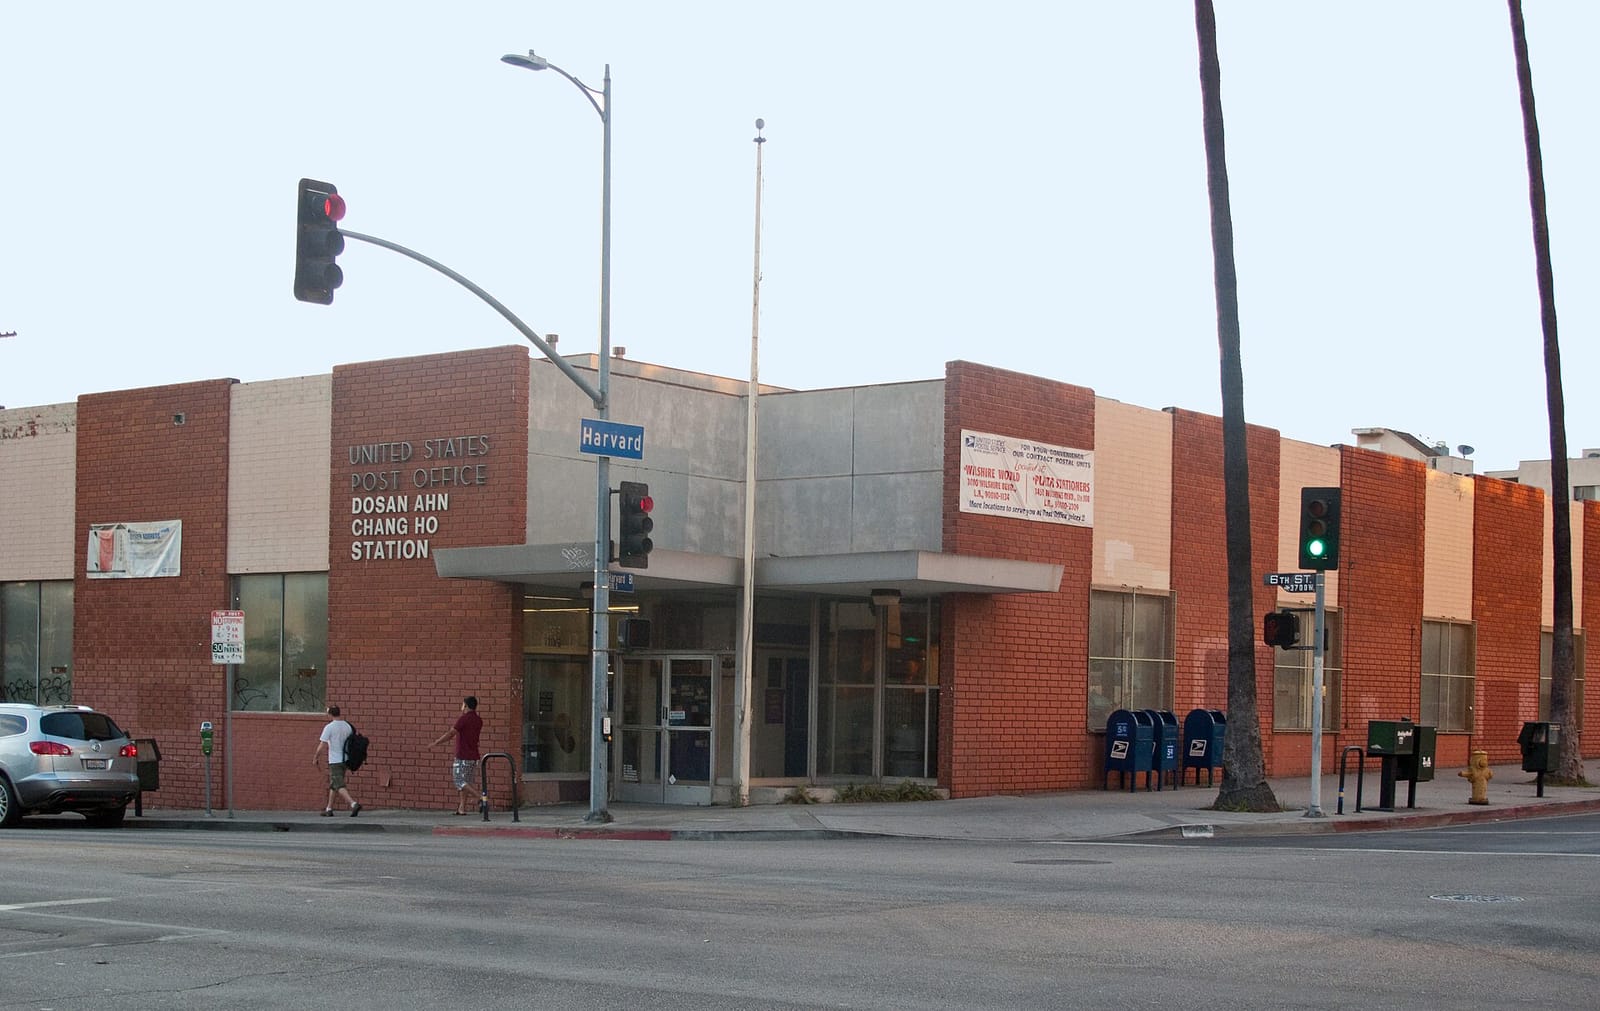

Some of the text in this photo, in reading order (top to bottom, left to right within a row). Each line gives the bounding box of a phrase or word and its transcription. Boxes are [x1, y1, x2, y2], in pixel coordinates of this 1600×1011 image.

[583, 426, 642, 451] Harvard
[349, 435, 490, 465] UNITED STATES
[1012, 450, 1091, 469] OUR CONTRACT POSTAL UNITS
[1032, 446, 1048, 455] YOUR
[1049, 449, 1084, 460] CONVENIENCE
[351, 464, 487, 492] POST OFFICE
[998, 470, 1020, 482] WORLD
[351, 493, 449, 514] DOSAN AHN
[983, 502, 1006, 511] locations
[351, 516, 439, 536] CHANG HO
[351, 539, 429, 560] STATION
[1270, 574, 1312, 584] 6TH ST.
[213, 616, 223, 625] NO
[213, 643, 223, 652] 30
